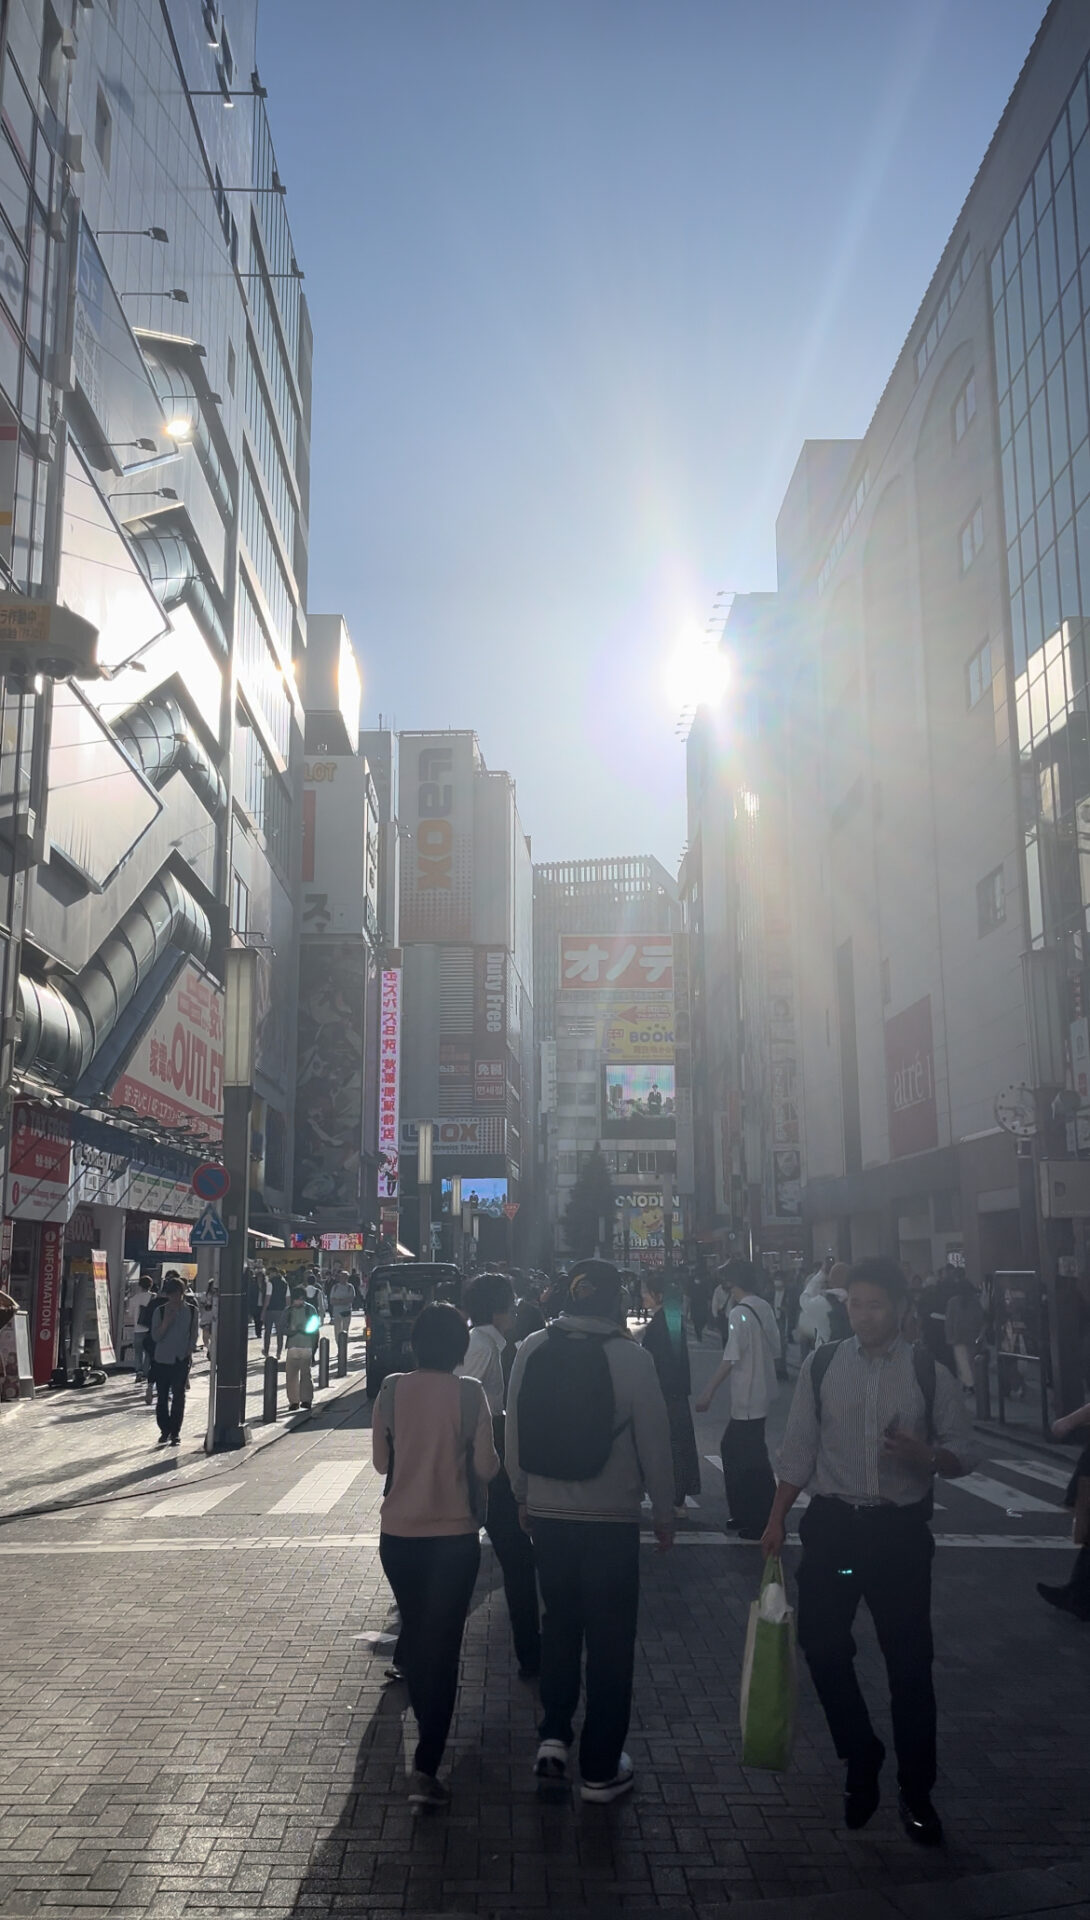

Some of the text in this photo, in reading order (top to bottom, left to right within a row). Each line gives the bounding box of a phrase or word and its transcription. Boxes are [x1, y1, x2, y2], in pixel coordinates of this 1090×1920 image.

[484, 952, 504, 1033] Duty Free
[629, 1030, 675, 1042] BOOK
[40, 1244, 57, 1327] INFORMATION
